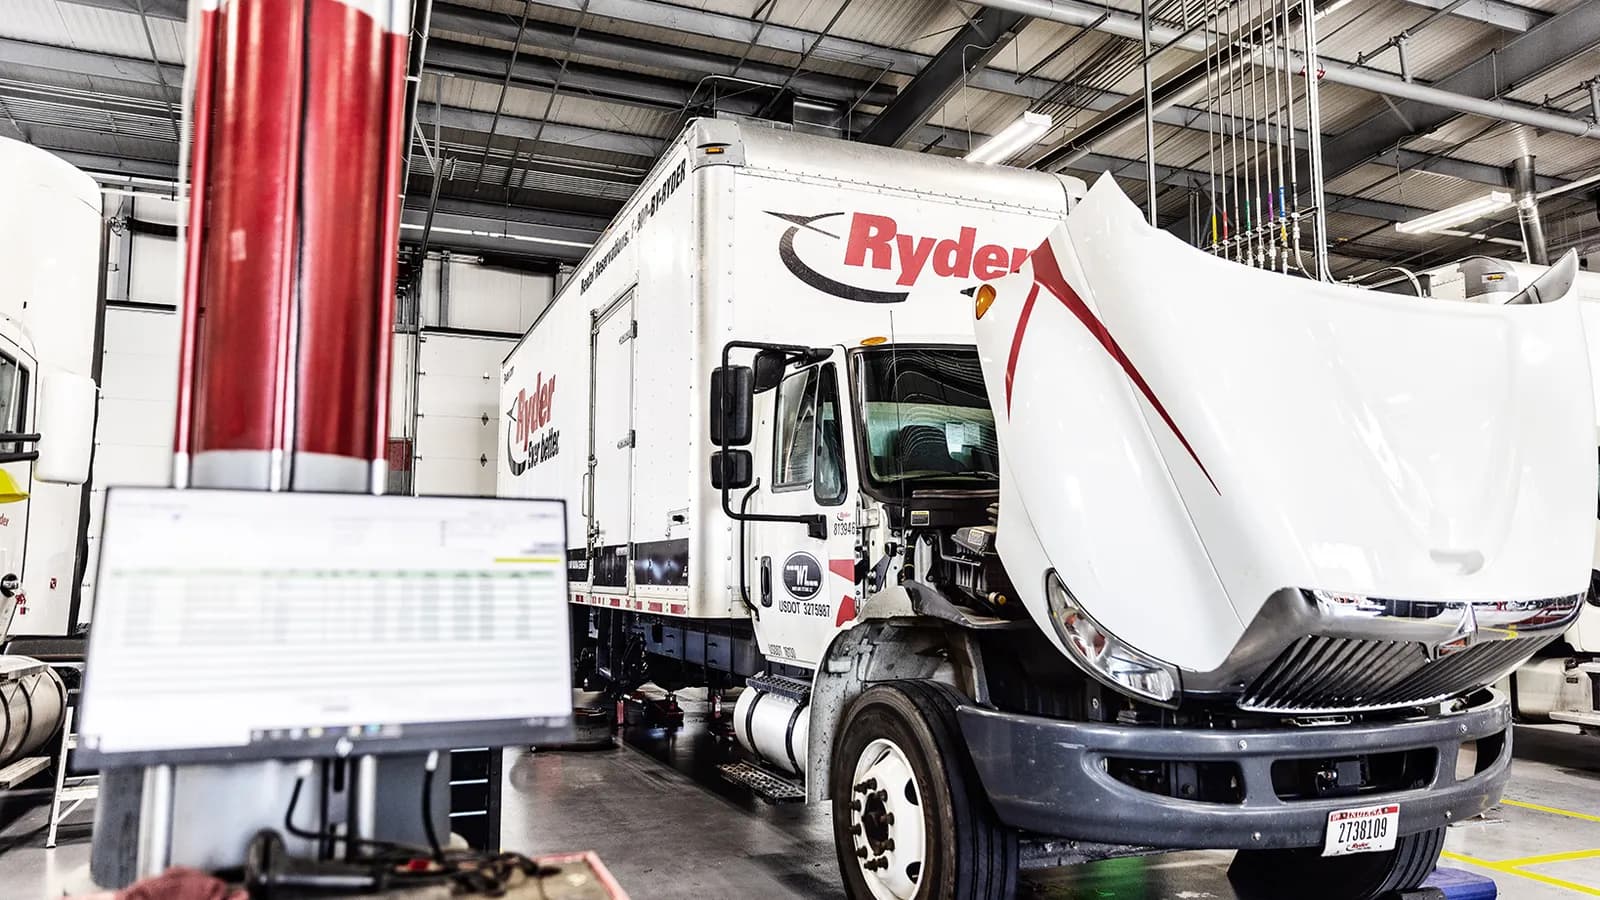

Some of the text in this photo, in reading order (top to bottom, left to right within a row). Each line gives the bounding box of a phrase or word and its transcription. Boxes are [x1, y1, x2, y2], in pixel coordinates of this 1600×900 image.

[844, 212, 1029, 287] Ryder
[516, 371, 556, 453] Ryder
[833, 521, 856, 536] 813946
[778, 600, 801, 614] USDOT
[1338, 817, 1388, 844] 2738109
